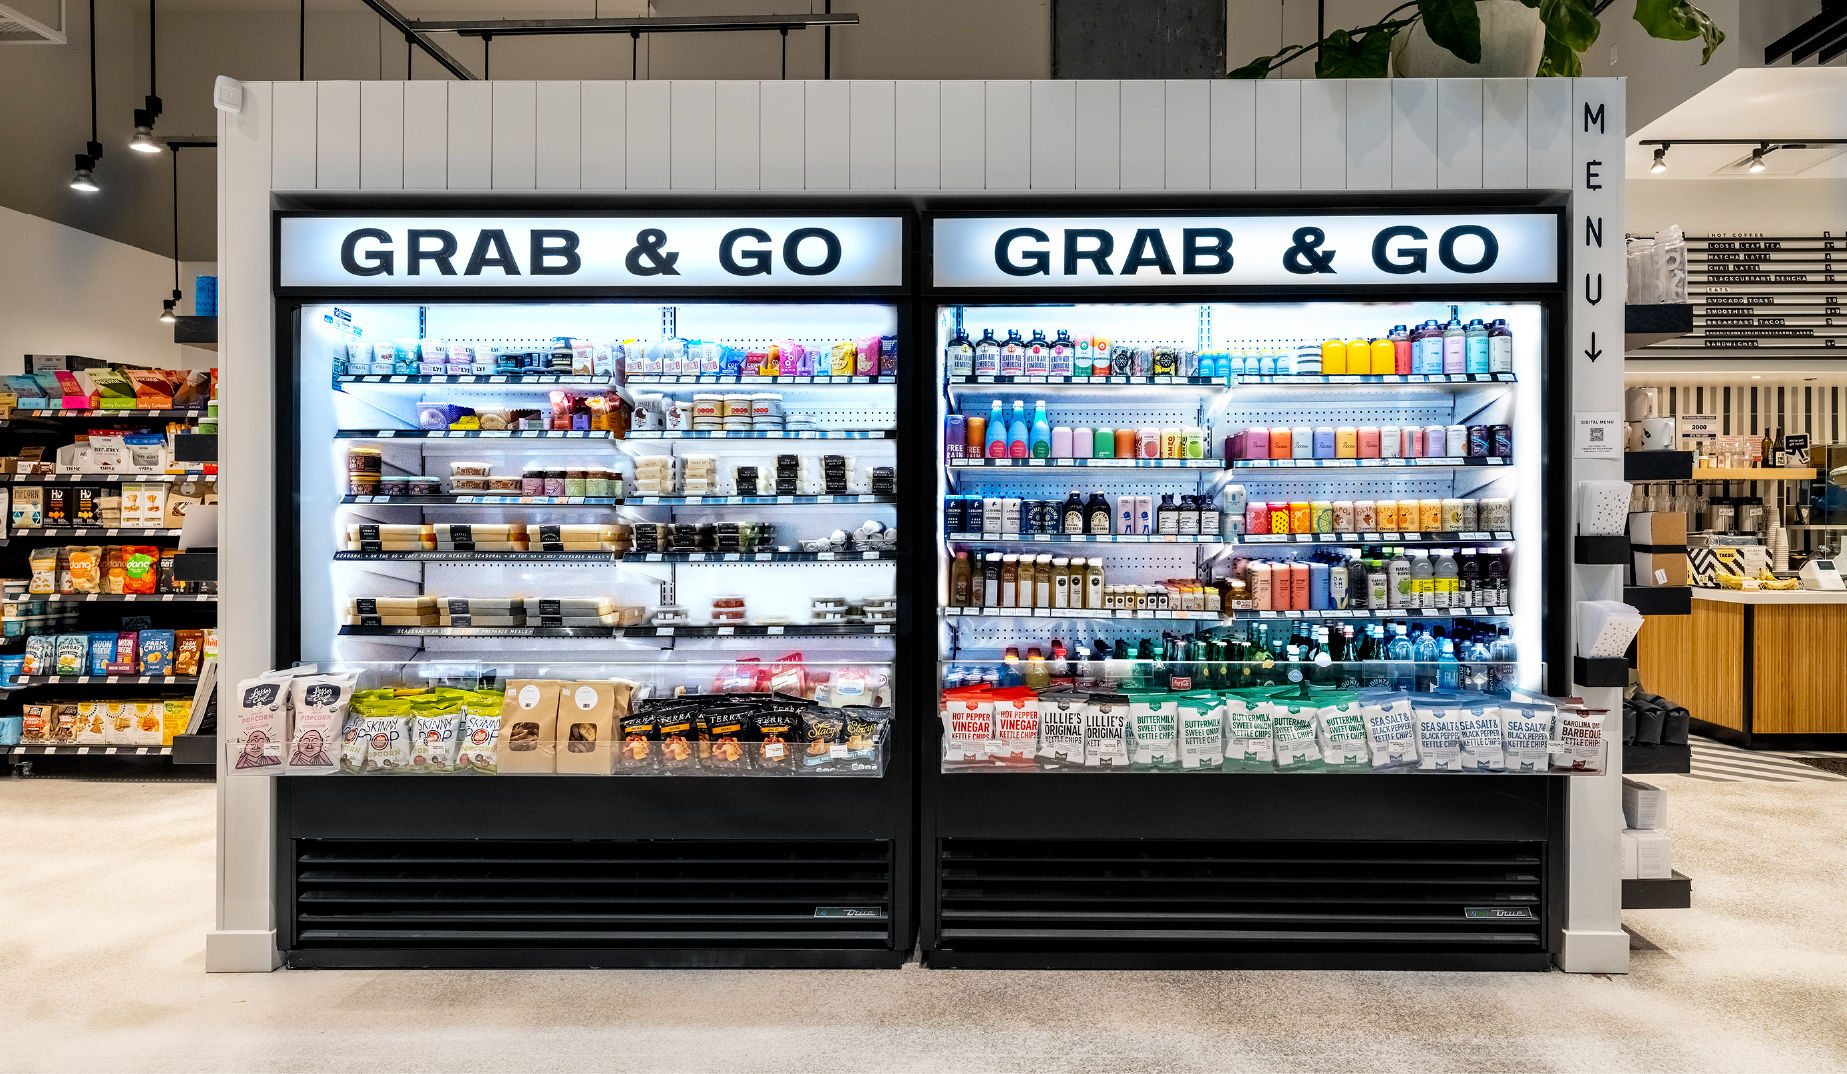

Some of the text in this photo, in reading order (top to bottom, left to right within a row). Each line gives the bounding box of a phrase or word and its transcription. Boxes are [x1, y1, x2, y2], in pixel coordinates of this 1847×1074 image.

[1584, 102, 1604, 305] MENU
[340, 227, 842, 278] GRAB & GO
[994, 224, 1500, 277] GRAB & GO
[946, 444, 963, 452] FREE
[14, 489, 39, 499] PIPCORN
[70, 559, 92, 570] dang
[126, 559, 151, 571] dang
[241, 713, 274, 725] POPCORN
[660, 712, 692, 724] TERRA
[710, 714, 741, 724] TERRA
[952, 712, 991, 721] HOT PEPPER
[1000, 710, 1038, 719] HOT PEPPER
[1044, 712, 1082, 724] LILLIE'S
[1136, 714, 1175, 724] BUTTERMILK
[1232, 712, 1271, 722] BUTTERMILK
[1370, 712, 1411, 727] SEA SALT &
[366, 718, 399, 733] SKINNY
[417, 717, 453, 731] SKINNY
[1000, 719, 1038, 731] VINEGAR
[1086, 715, 1124, 727] LILLIE'S
[1184, 718, 1221, 729] BUTTERMILK
[1232, 721, 1253, 730] SWEET
[1326, 714, 1364, 727] BUTTERMILK
[1460, 719, 1499, 731] SEA SALT &
[1563, 719, 1591, 729] CAROLINA
[808, 721, 841, 740] Stacy's
[952, 721, 990, 733] VINEGAR
[1044, 724, 1082, 736] ORIGINAL
[1137, 724, 1175, 732] SWEET ONION
[1184, 728, 1204, 736] SWEET
[1275, 725, 1293, 734] SWEET
[1329, 724, 1348, 734] SWEET
[1372, 721, 1412, 735] BLACK PEPPER
[1421, 721, 1436, 732] SEA
[1436, 721, 1454, 731] SALT
[1508, 721, 1543, 732] SEA SALT
[418, 729, 453, 747] POP
[952, 732, 971, 740] KETTLE
[999, 730, 1038, 739] KETTLE CHIPS
[1086, 727, 1123, 739] ORIGINAL
[1137, 731, 1175, 740] KETTLE CHIPS
[1254, 730, 1272, 738] CHIPS
[1276, 729, 1314, 742] KETTLE CHIPS
[1350, 731, 1367, 740] CHIPS
[1373, 730, 1413, 743] KETTLE CHIPS
[1421, 731, 1440, 740] BLACK
[1461, 729, 1500, 738] BLACK PEPPER
[1507, 731, 1527, 740] BLACK
[1562, 726, 1601, 740] BARBEQUE
[1045, 735, 1082, 745] KETTLE CHIPS
[1185, 736, 1206, 745] KETTLE
[1421, 740, 1443, 748] KETTLE
[1463, 738, 1501, 747] KETTLE CHIPS
[1507, 740, 1548, 749] KETTLE CHIPS
[1561, 735, 1584, 746] KETTLE
[1490, 908, 1526, 917] True
